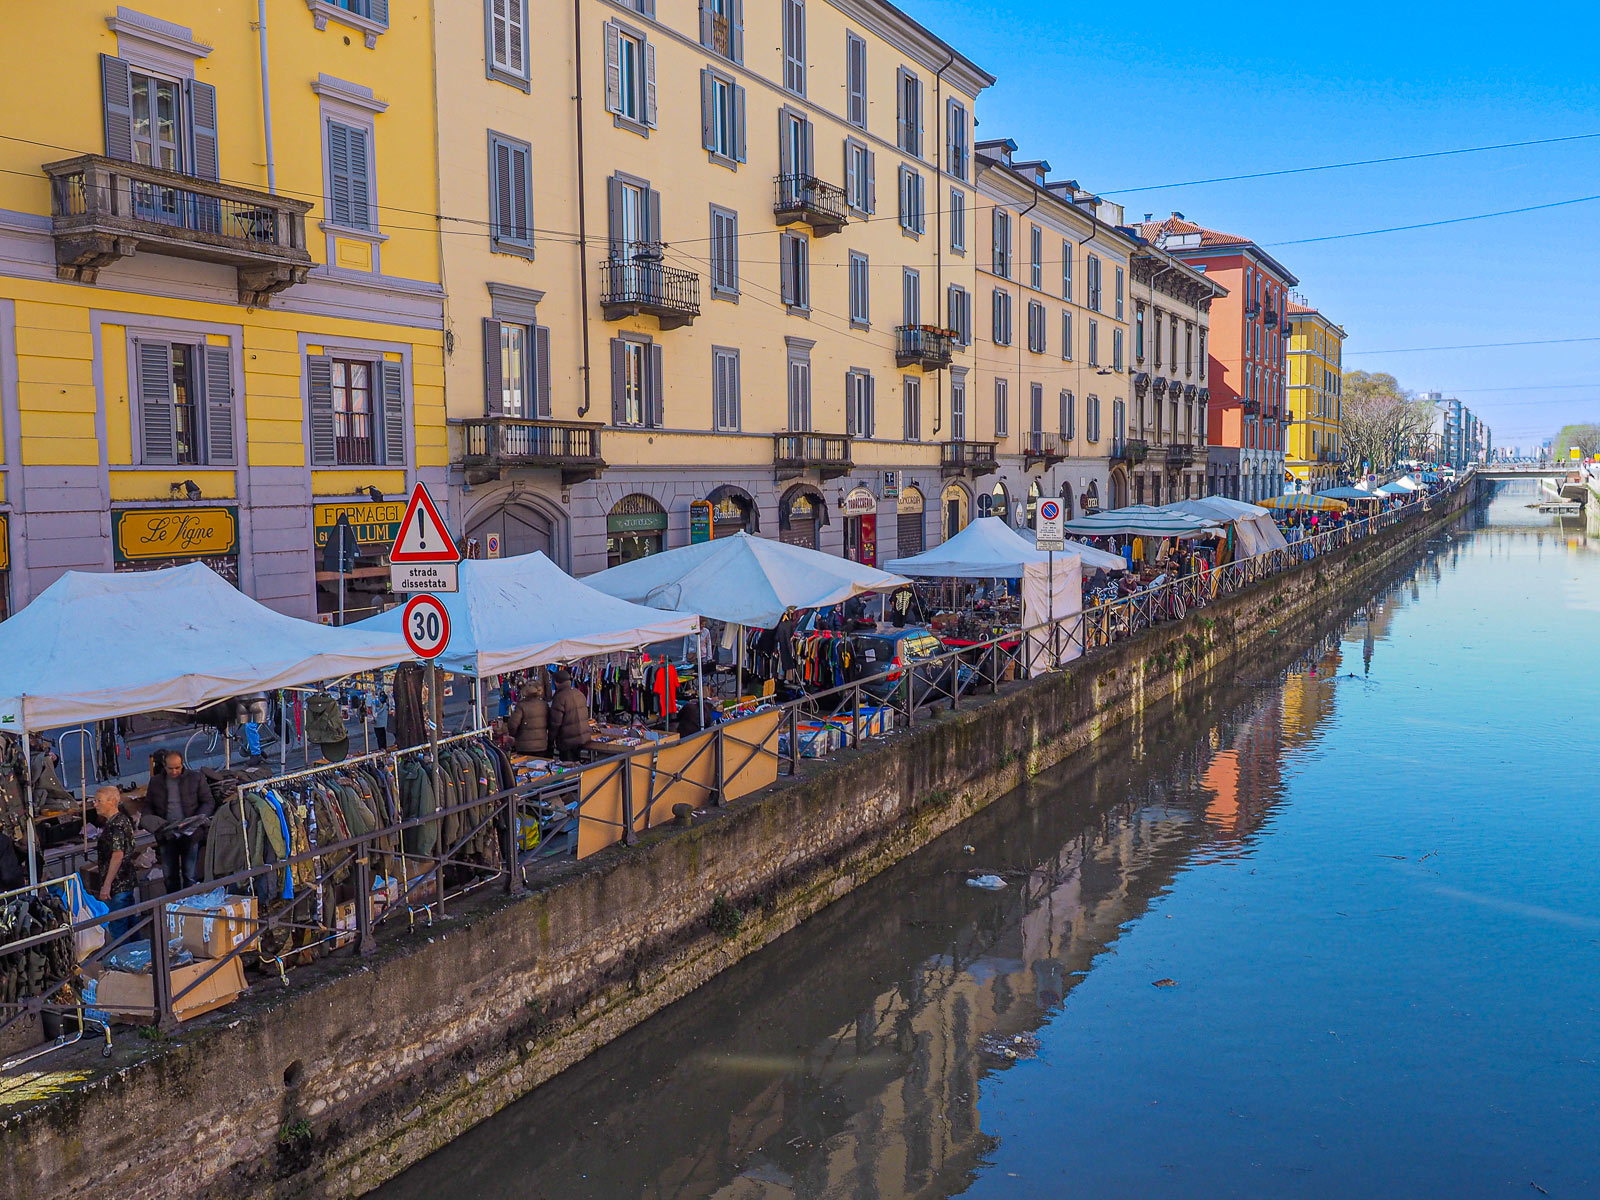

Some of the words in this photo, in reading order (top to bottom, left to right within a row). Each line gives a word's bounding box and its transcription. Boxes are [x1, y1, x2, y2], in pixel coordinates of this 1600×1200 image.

[324, 505, 400, 525] FORMAGGI
[140, 516, 170, 544] Le
[168, 515, 214, 549] Vigne
[409, 567, 438, 577] strada
[401, 579, 447, 589] dissestata
[413, 611, 439, 641] 30
